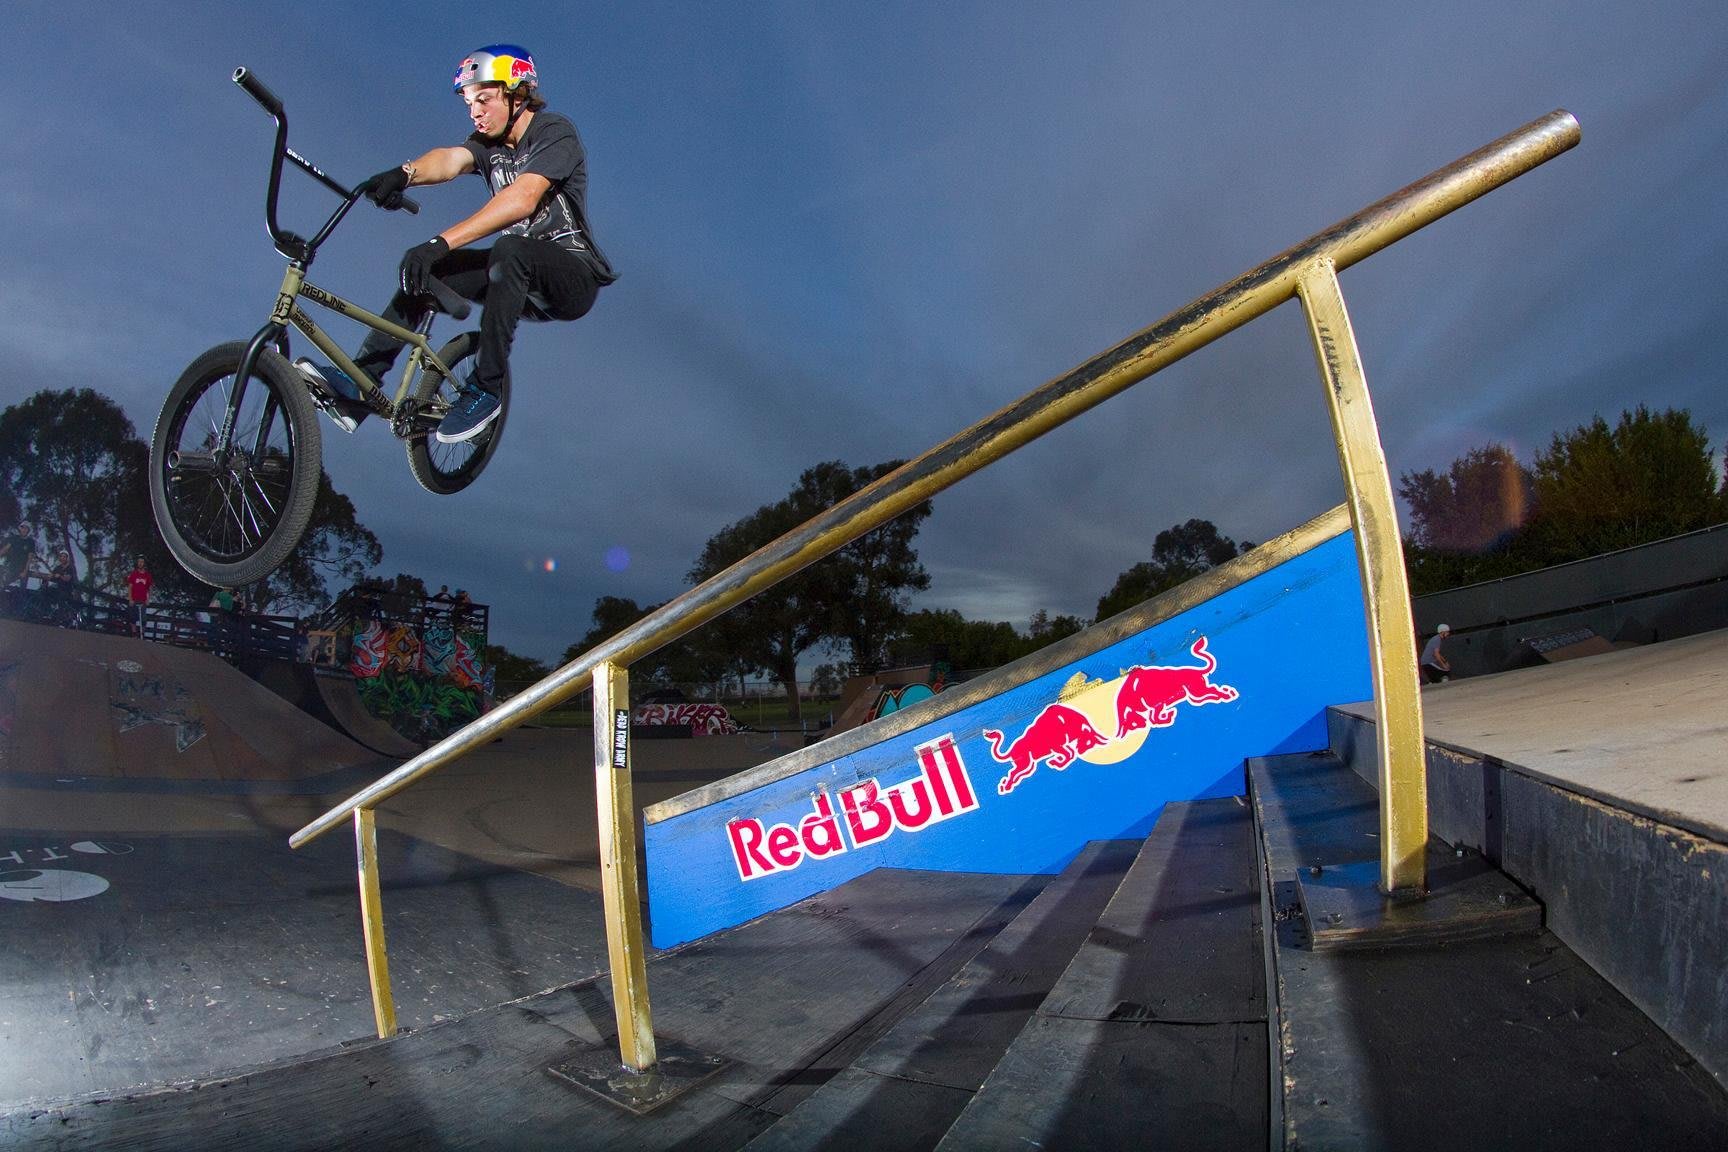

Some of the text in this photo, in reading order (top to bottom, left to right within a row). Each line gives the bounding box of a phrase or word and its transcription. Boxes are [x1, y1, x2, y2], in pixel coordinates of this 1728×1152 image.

[302, 283, 346, 311] REDLINE
[614, 750, 626, 767] ARMY
[727, 735, 977, 878] Red Bull
